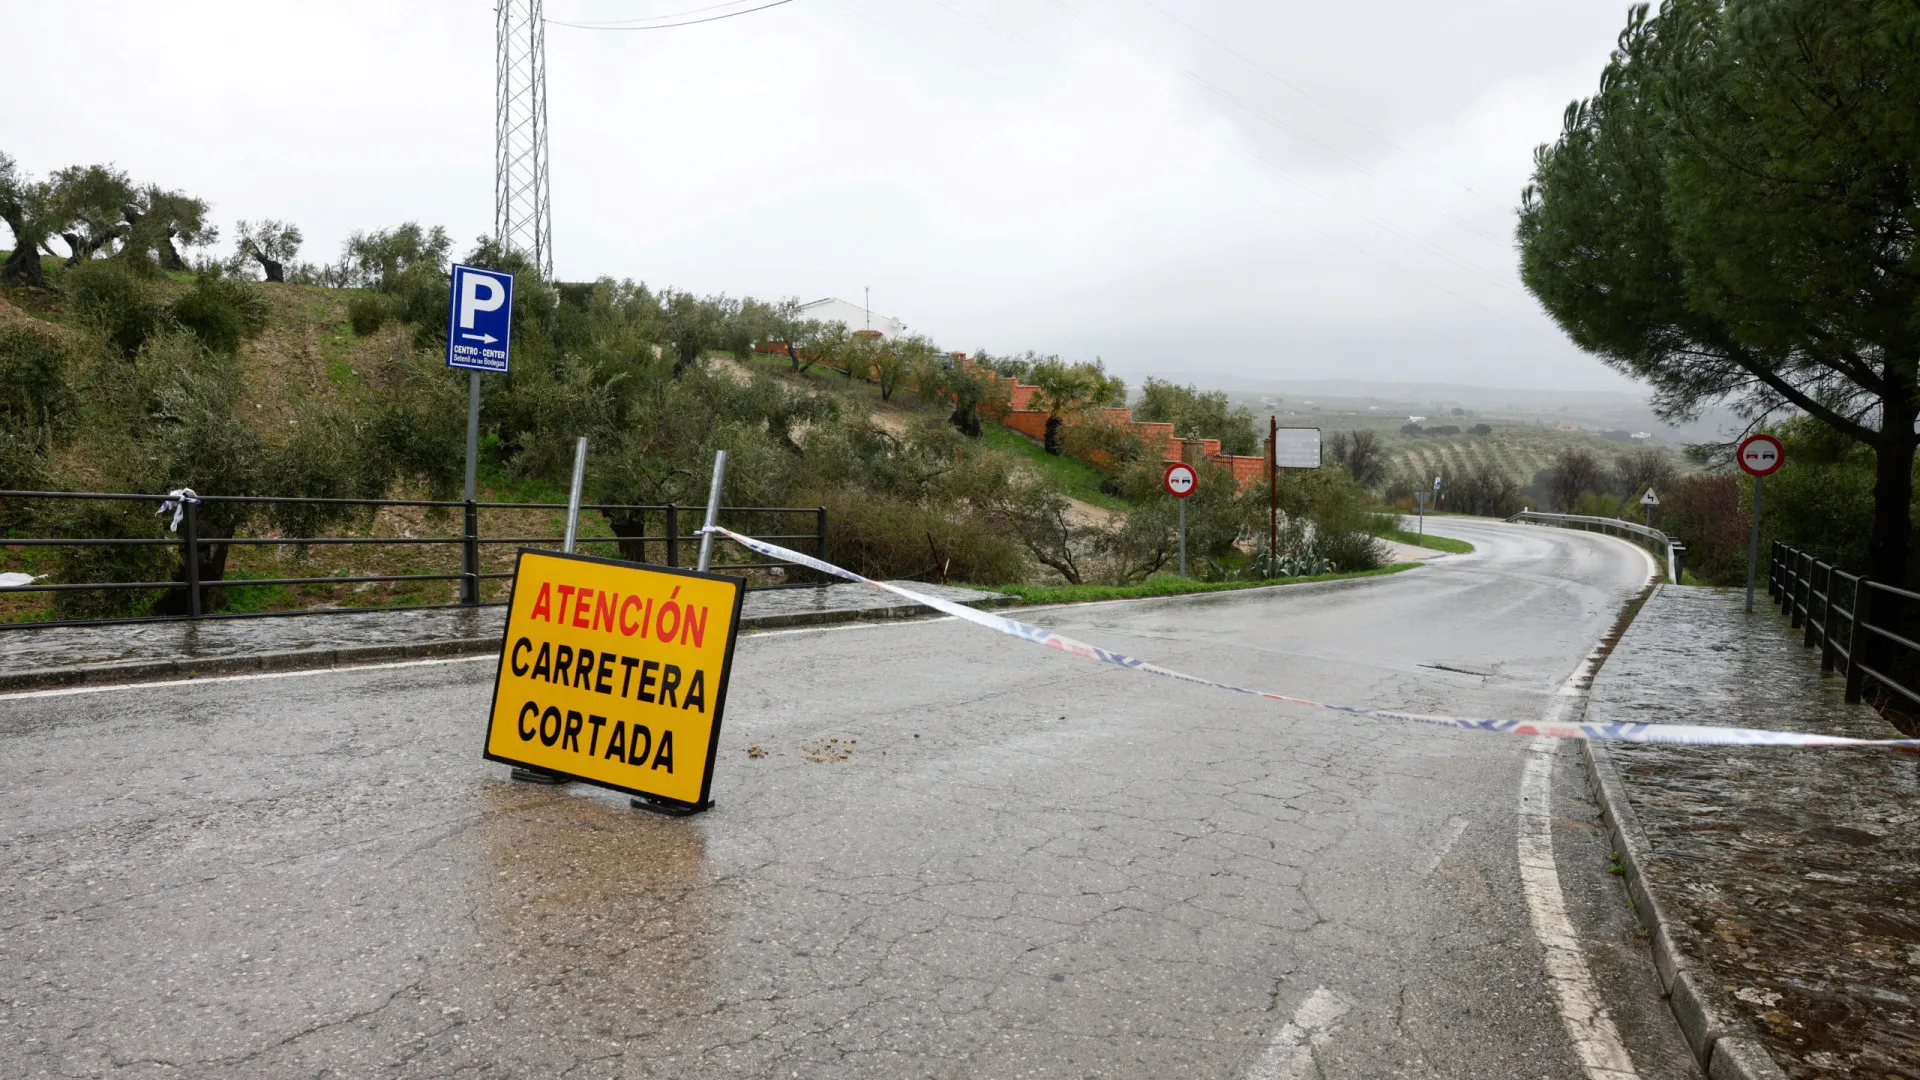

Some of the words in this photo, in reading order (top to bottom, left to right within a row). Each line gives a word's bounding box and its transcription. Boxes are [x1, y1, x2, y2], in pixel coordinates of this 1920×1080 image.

[460, 272, 505, 329] P
[454, 345, 477, 356] CENTRO
[482, 348, 505, 359] CENTER
[454, 354, 471, 363] Setenil
[484, 357, 505, 368] Bodegas
[530, 582, 708, 648] ATENCIÓN
[511, 637, 705, 713] CARRETERA
[518, 701, 674, 774] CORTADA
